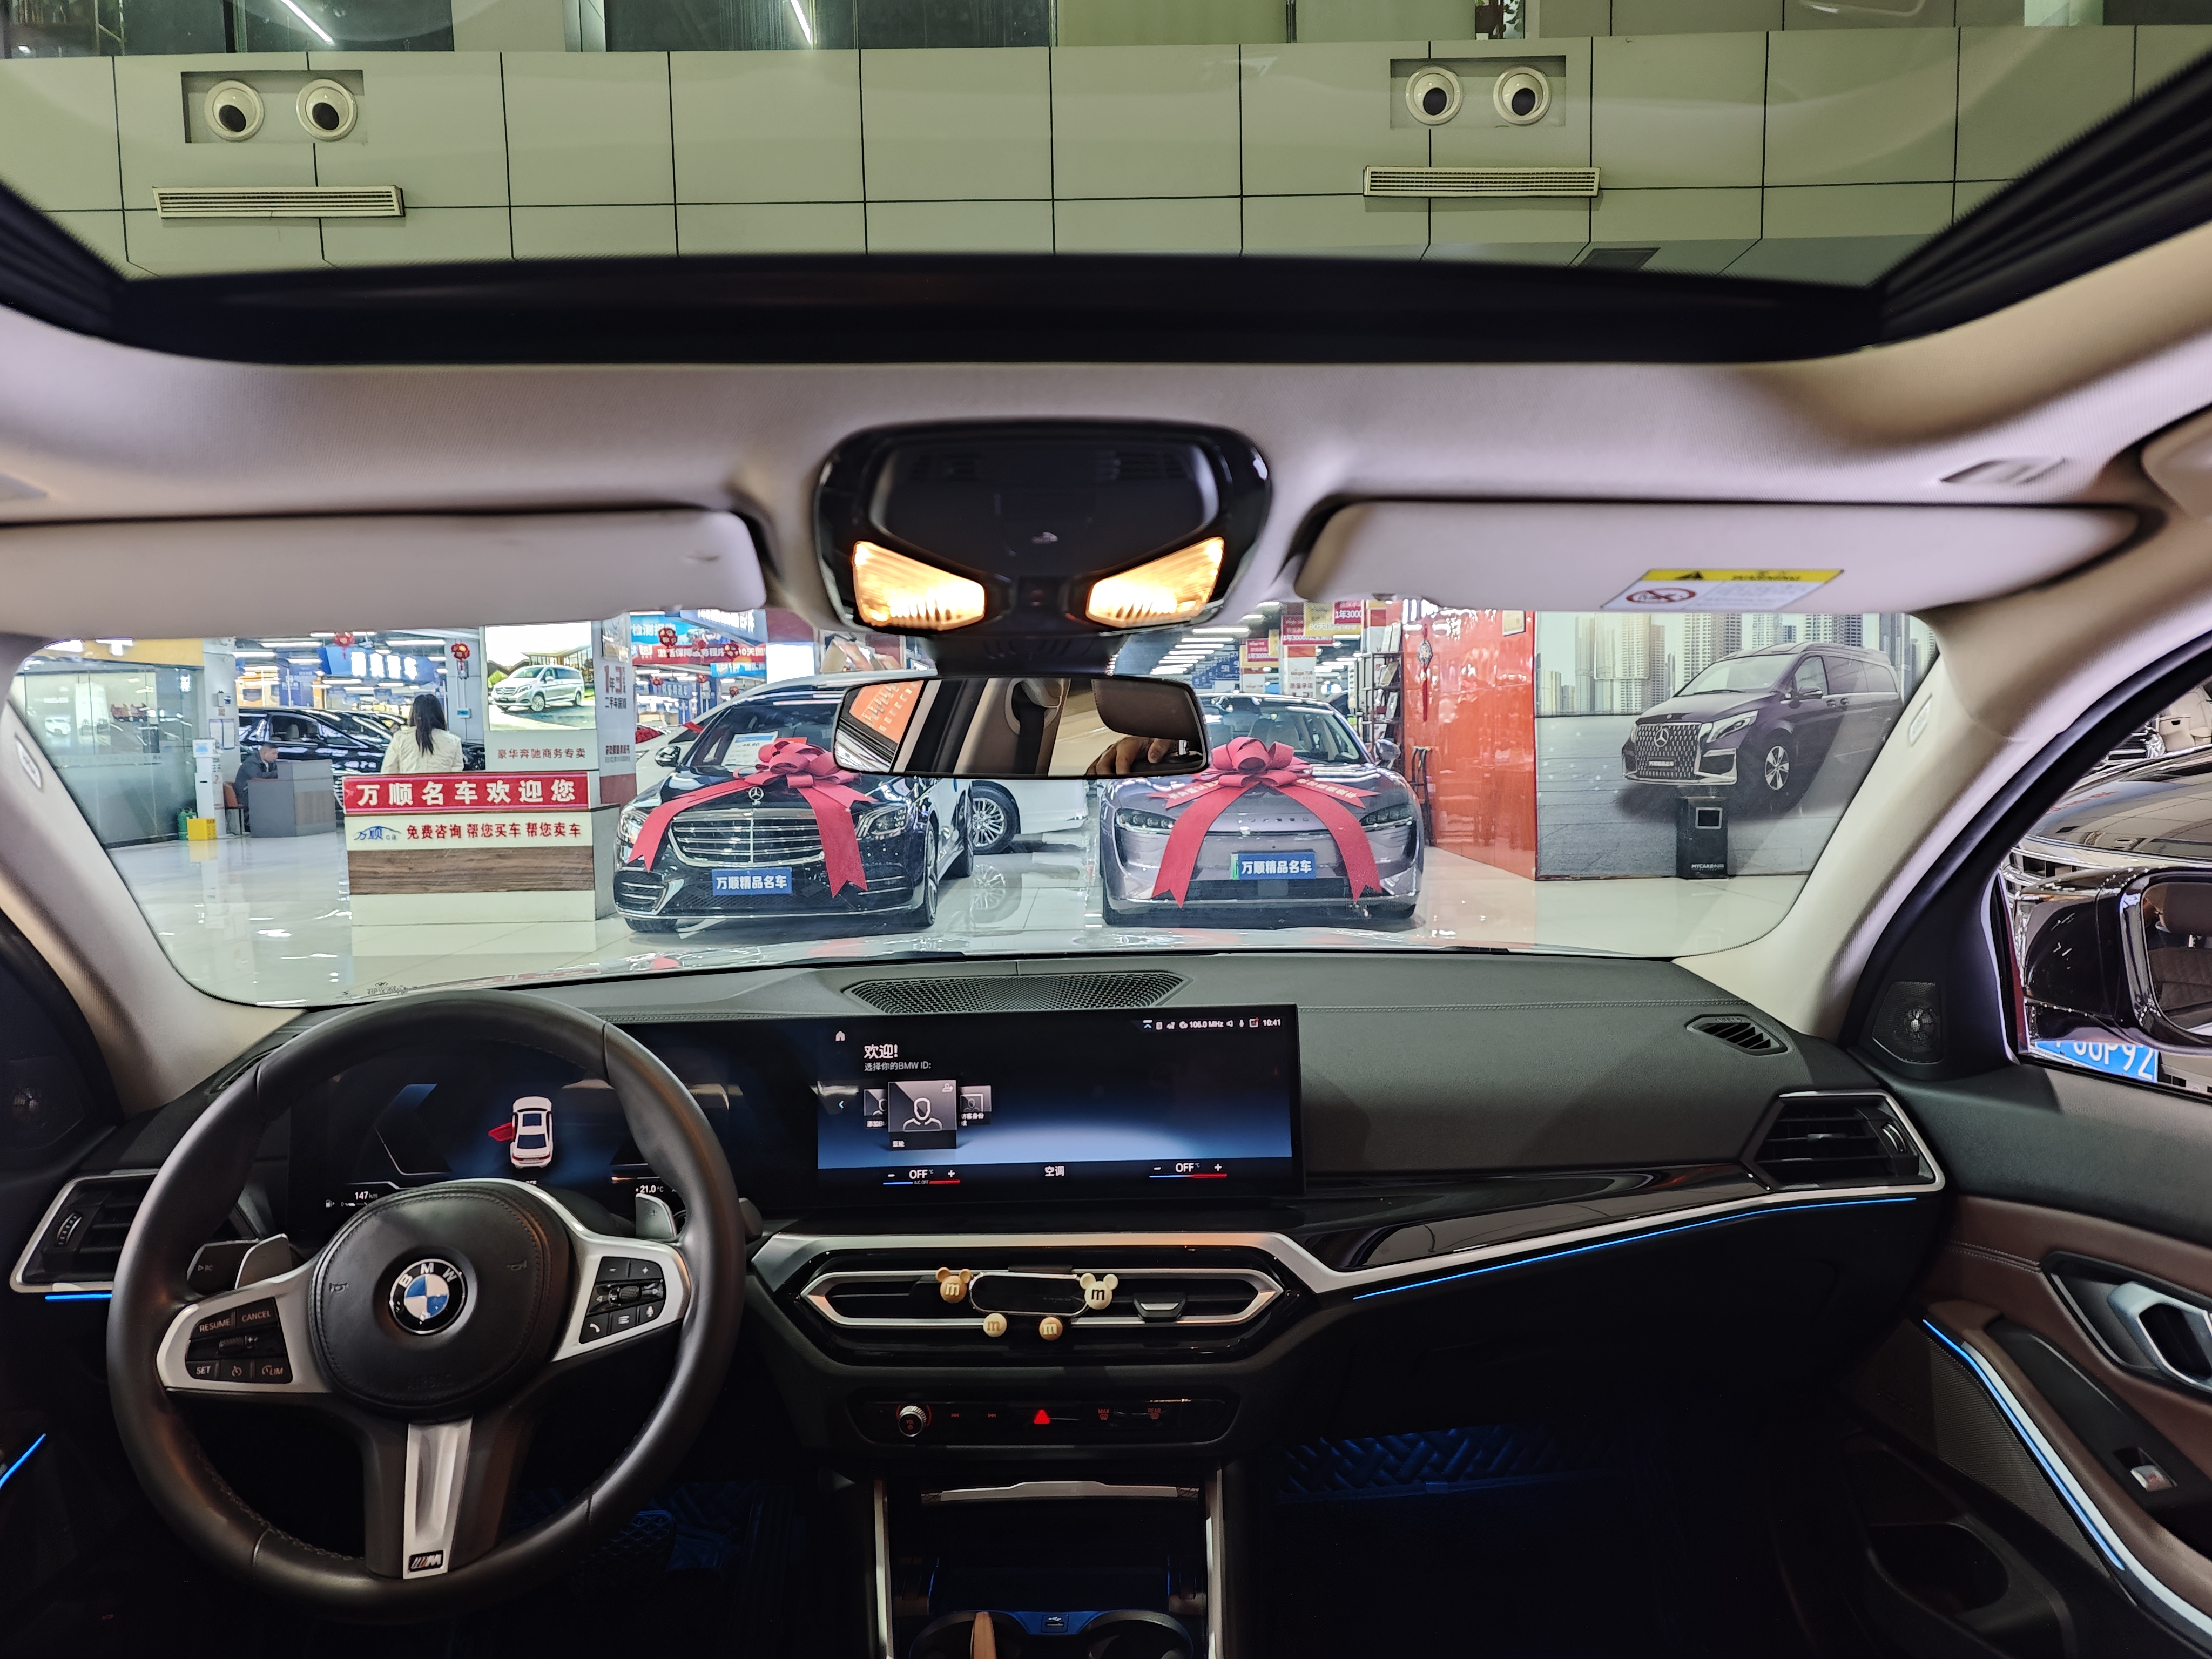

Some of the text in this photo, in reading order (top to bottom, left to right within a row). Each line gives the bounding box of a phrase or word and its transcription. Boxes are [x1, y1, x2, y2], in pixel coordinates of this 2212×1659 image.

[497, 748, 585, 759] 豪华奔驰商务专卖
[356, 779, 575, 806] 万顺名车欢迎您
[407, 822, 581, 839] 免费咨询 帮您买车 帮您卖车
[1241, 860, 1312, 874] 万顺精品名车
[716, 875, 787, 890] 万顺精品名车
[864, 1044, 898, 1059] 欢迎!
[864, 1061, 932, 1071] 选择你的BMW ID:
[1044, 1166, 1065, 1177] 空调
[1176, 1163, 1194, 1172] OFF
[909, 1169, 928, 1179] OFF
[355, 1191, 368, 1200] 147
[399, 1262, 457, 1288] BMW
[242, 1310, 271, 1323] CANCEL
[199, 1318, 231, 1332] RESUME
[196, 1366, 211, 1375] SET
[269, 1367, 284, 1375] LIM
